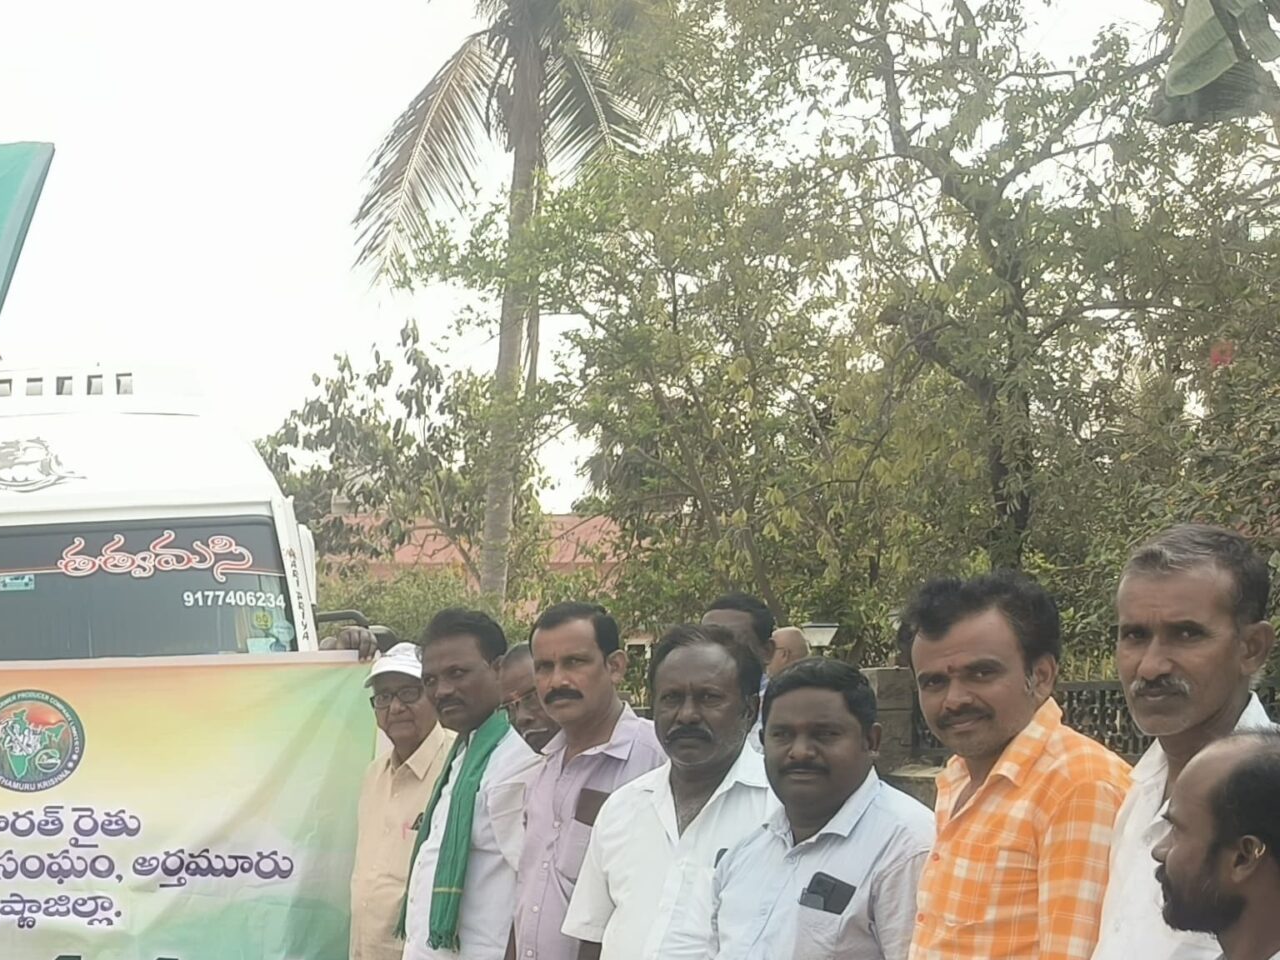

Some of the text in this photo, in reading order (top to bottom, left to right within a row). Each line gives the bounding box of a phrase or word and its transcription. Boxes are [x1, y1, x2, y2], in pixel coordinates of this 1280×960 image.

[57, 530, 253, 582] తత్వమసి
[183, 591, 286, 608] 9177406234
[37, 769, 71, 790] KRISHNA
[69, 807, 141, 848] రైతు
[132, 848, 295, 888] అర్తమూరు
